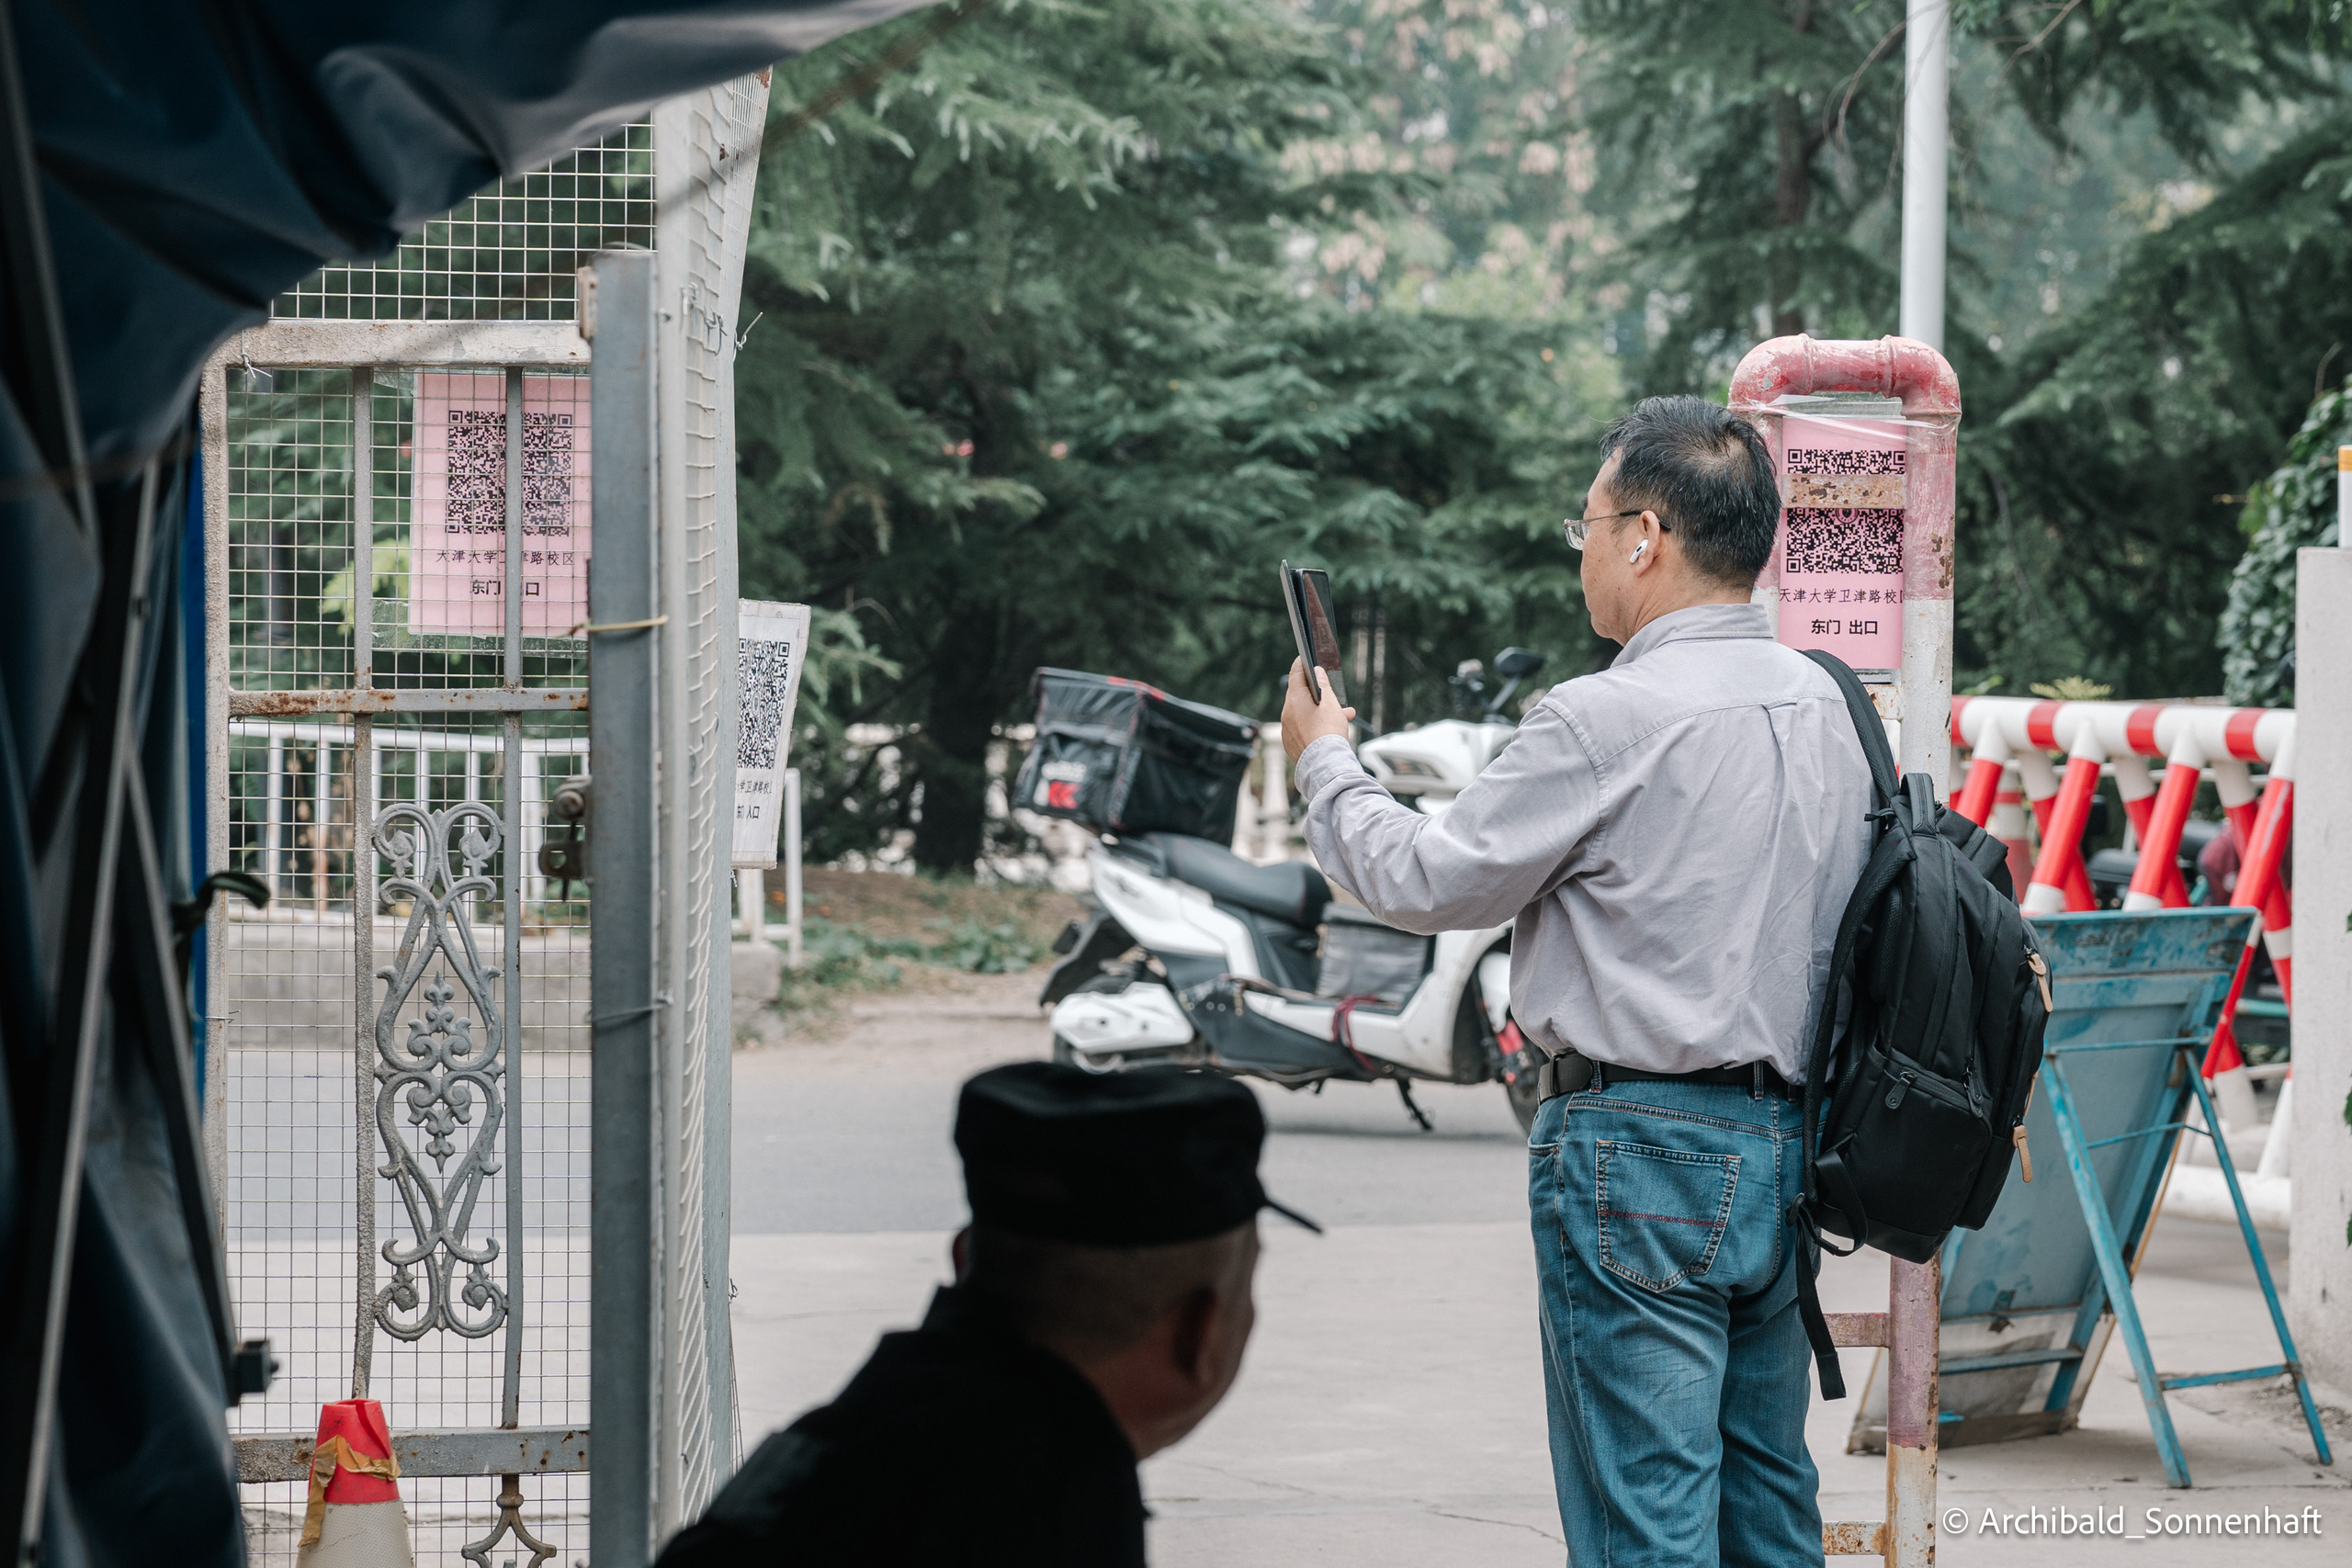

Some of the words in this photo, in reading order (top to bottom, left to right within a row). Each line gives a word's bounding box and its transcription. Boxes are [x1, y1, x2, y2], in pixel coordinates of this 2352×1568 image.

[435, 550, 574, 566] 天津大学路校区
[470, 580, 501, 595] 东门
[1811, 619, 1840, 635] 东门
[1849, 620, 1878, 635] 出口
[746, 805, 760, 818] 入口
